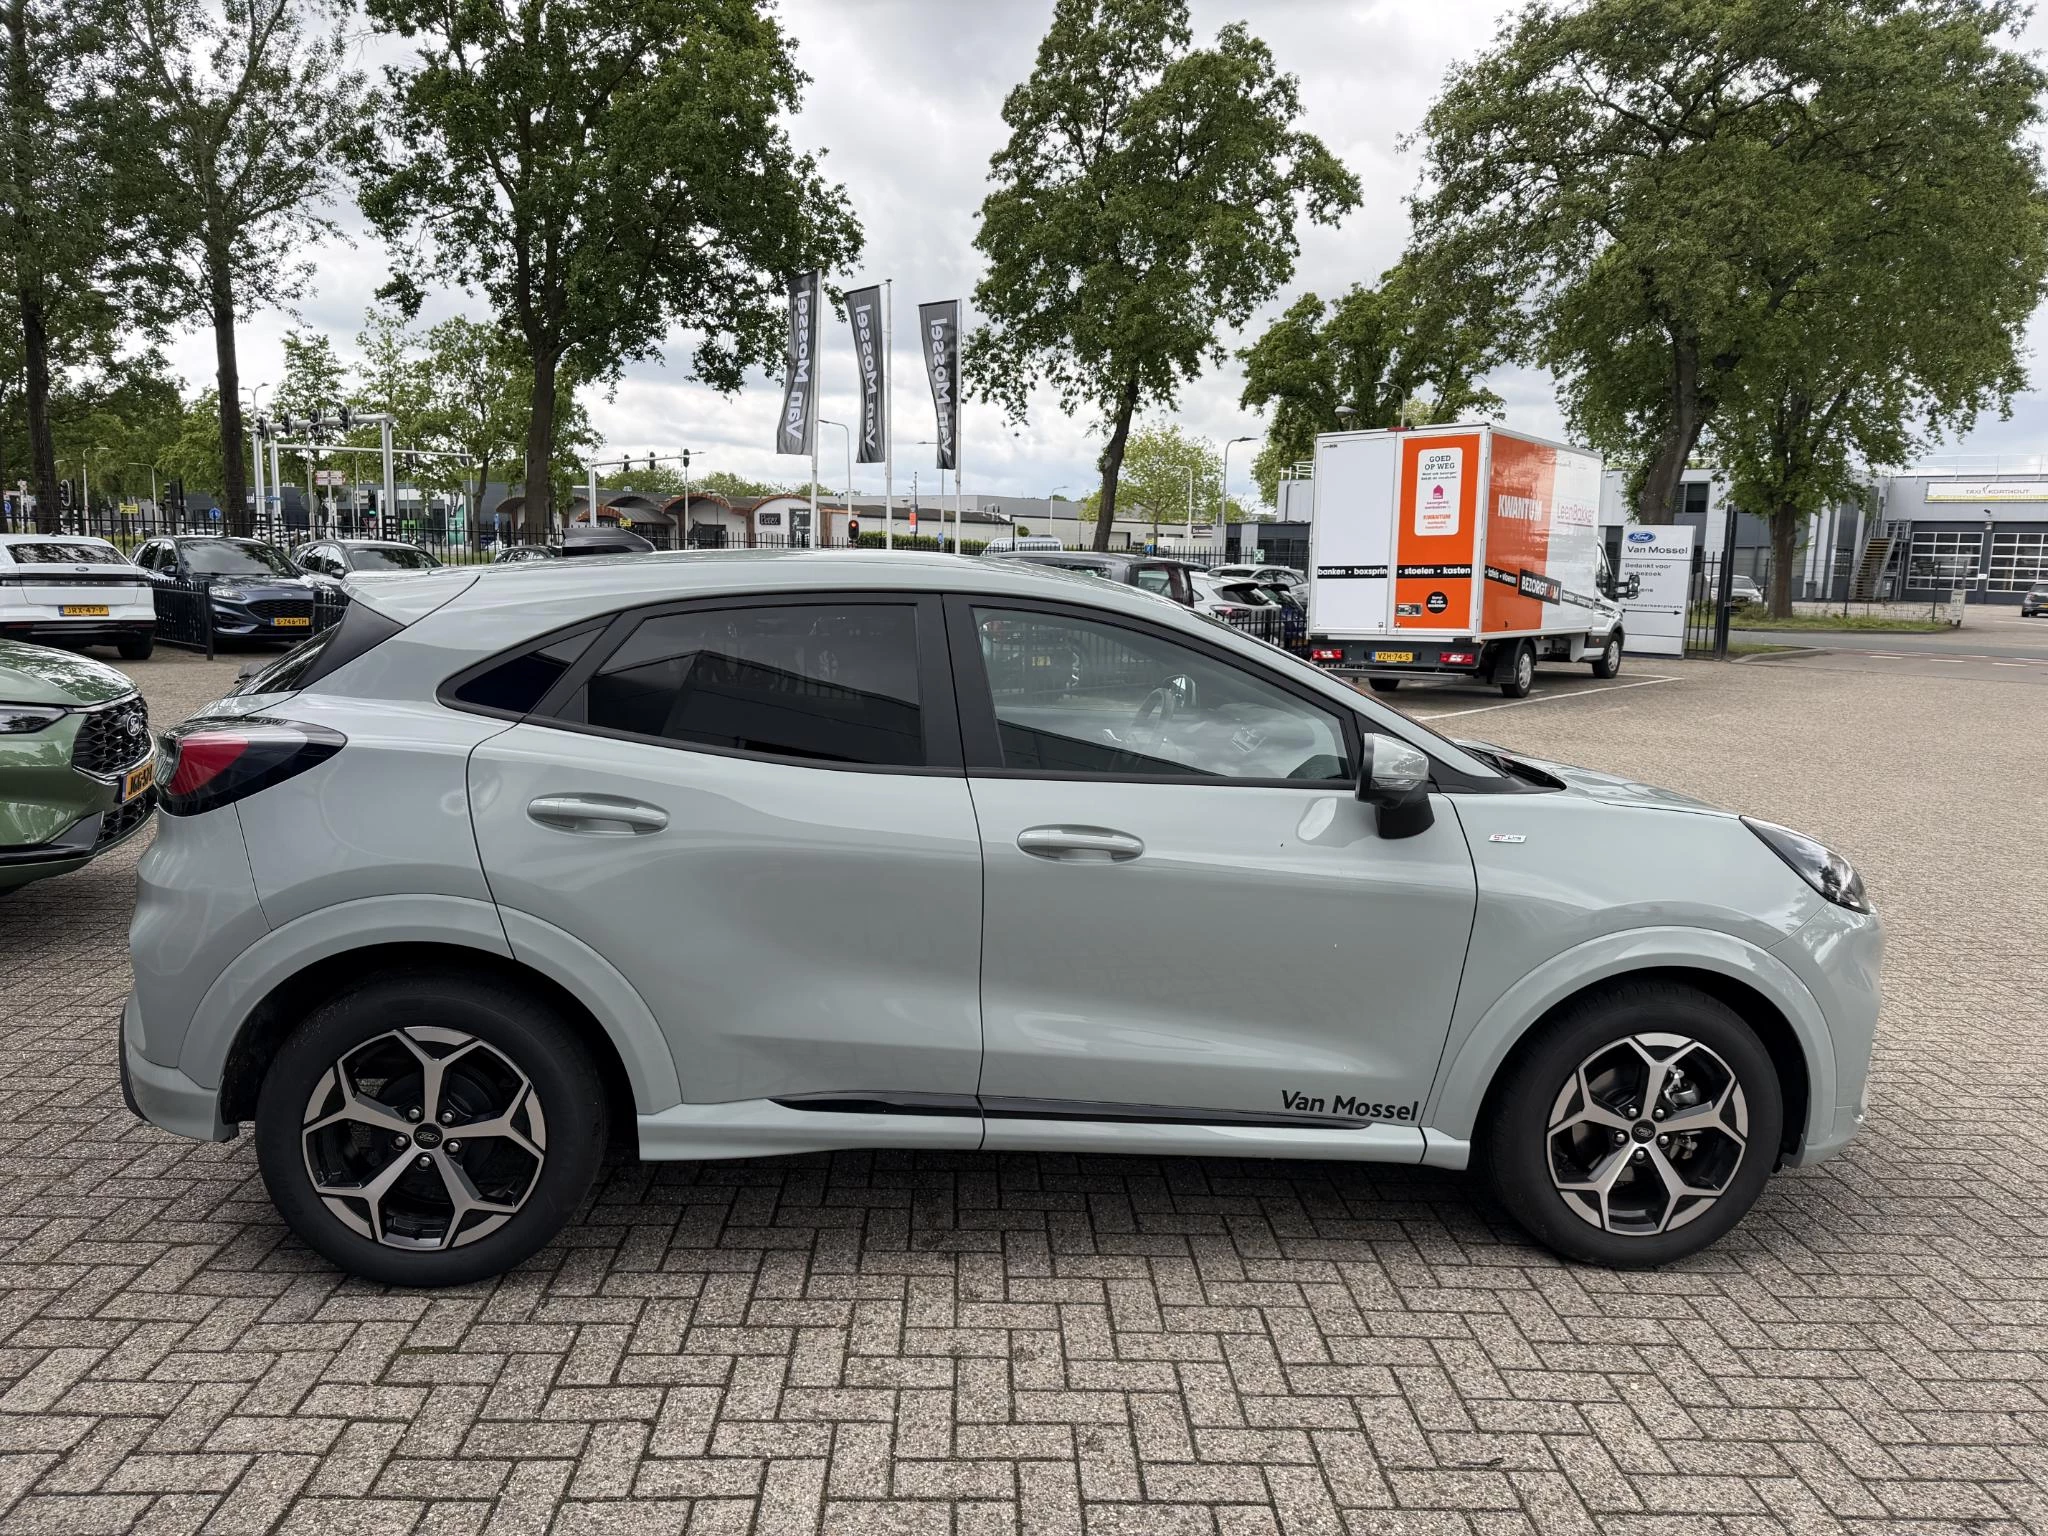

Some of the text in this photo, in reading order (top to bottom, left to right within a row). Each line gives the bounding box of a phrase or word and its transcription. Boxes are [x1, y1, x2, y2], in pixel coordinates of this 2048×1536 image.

[1429, 455, 1452, 463] GOED
[1424, 462, 1455, 471] OP WEG
[1497, 494, 1543, 521] KWANTUM
[1648, 546, 1688, 554] Mossel
[1318, 567, 1346, 576] banken
[1404, 565, 1471, 575] stoelen kasten
[1377, 652, 1410, 660] VZH-74-S
[1281, 1089, 1419, 1121] Van Mossel
